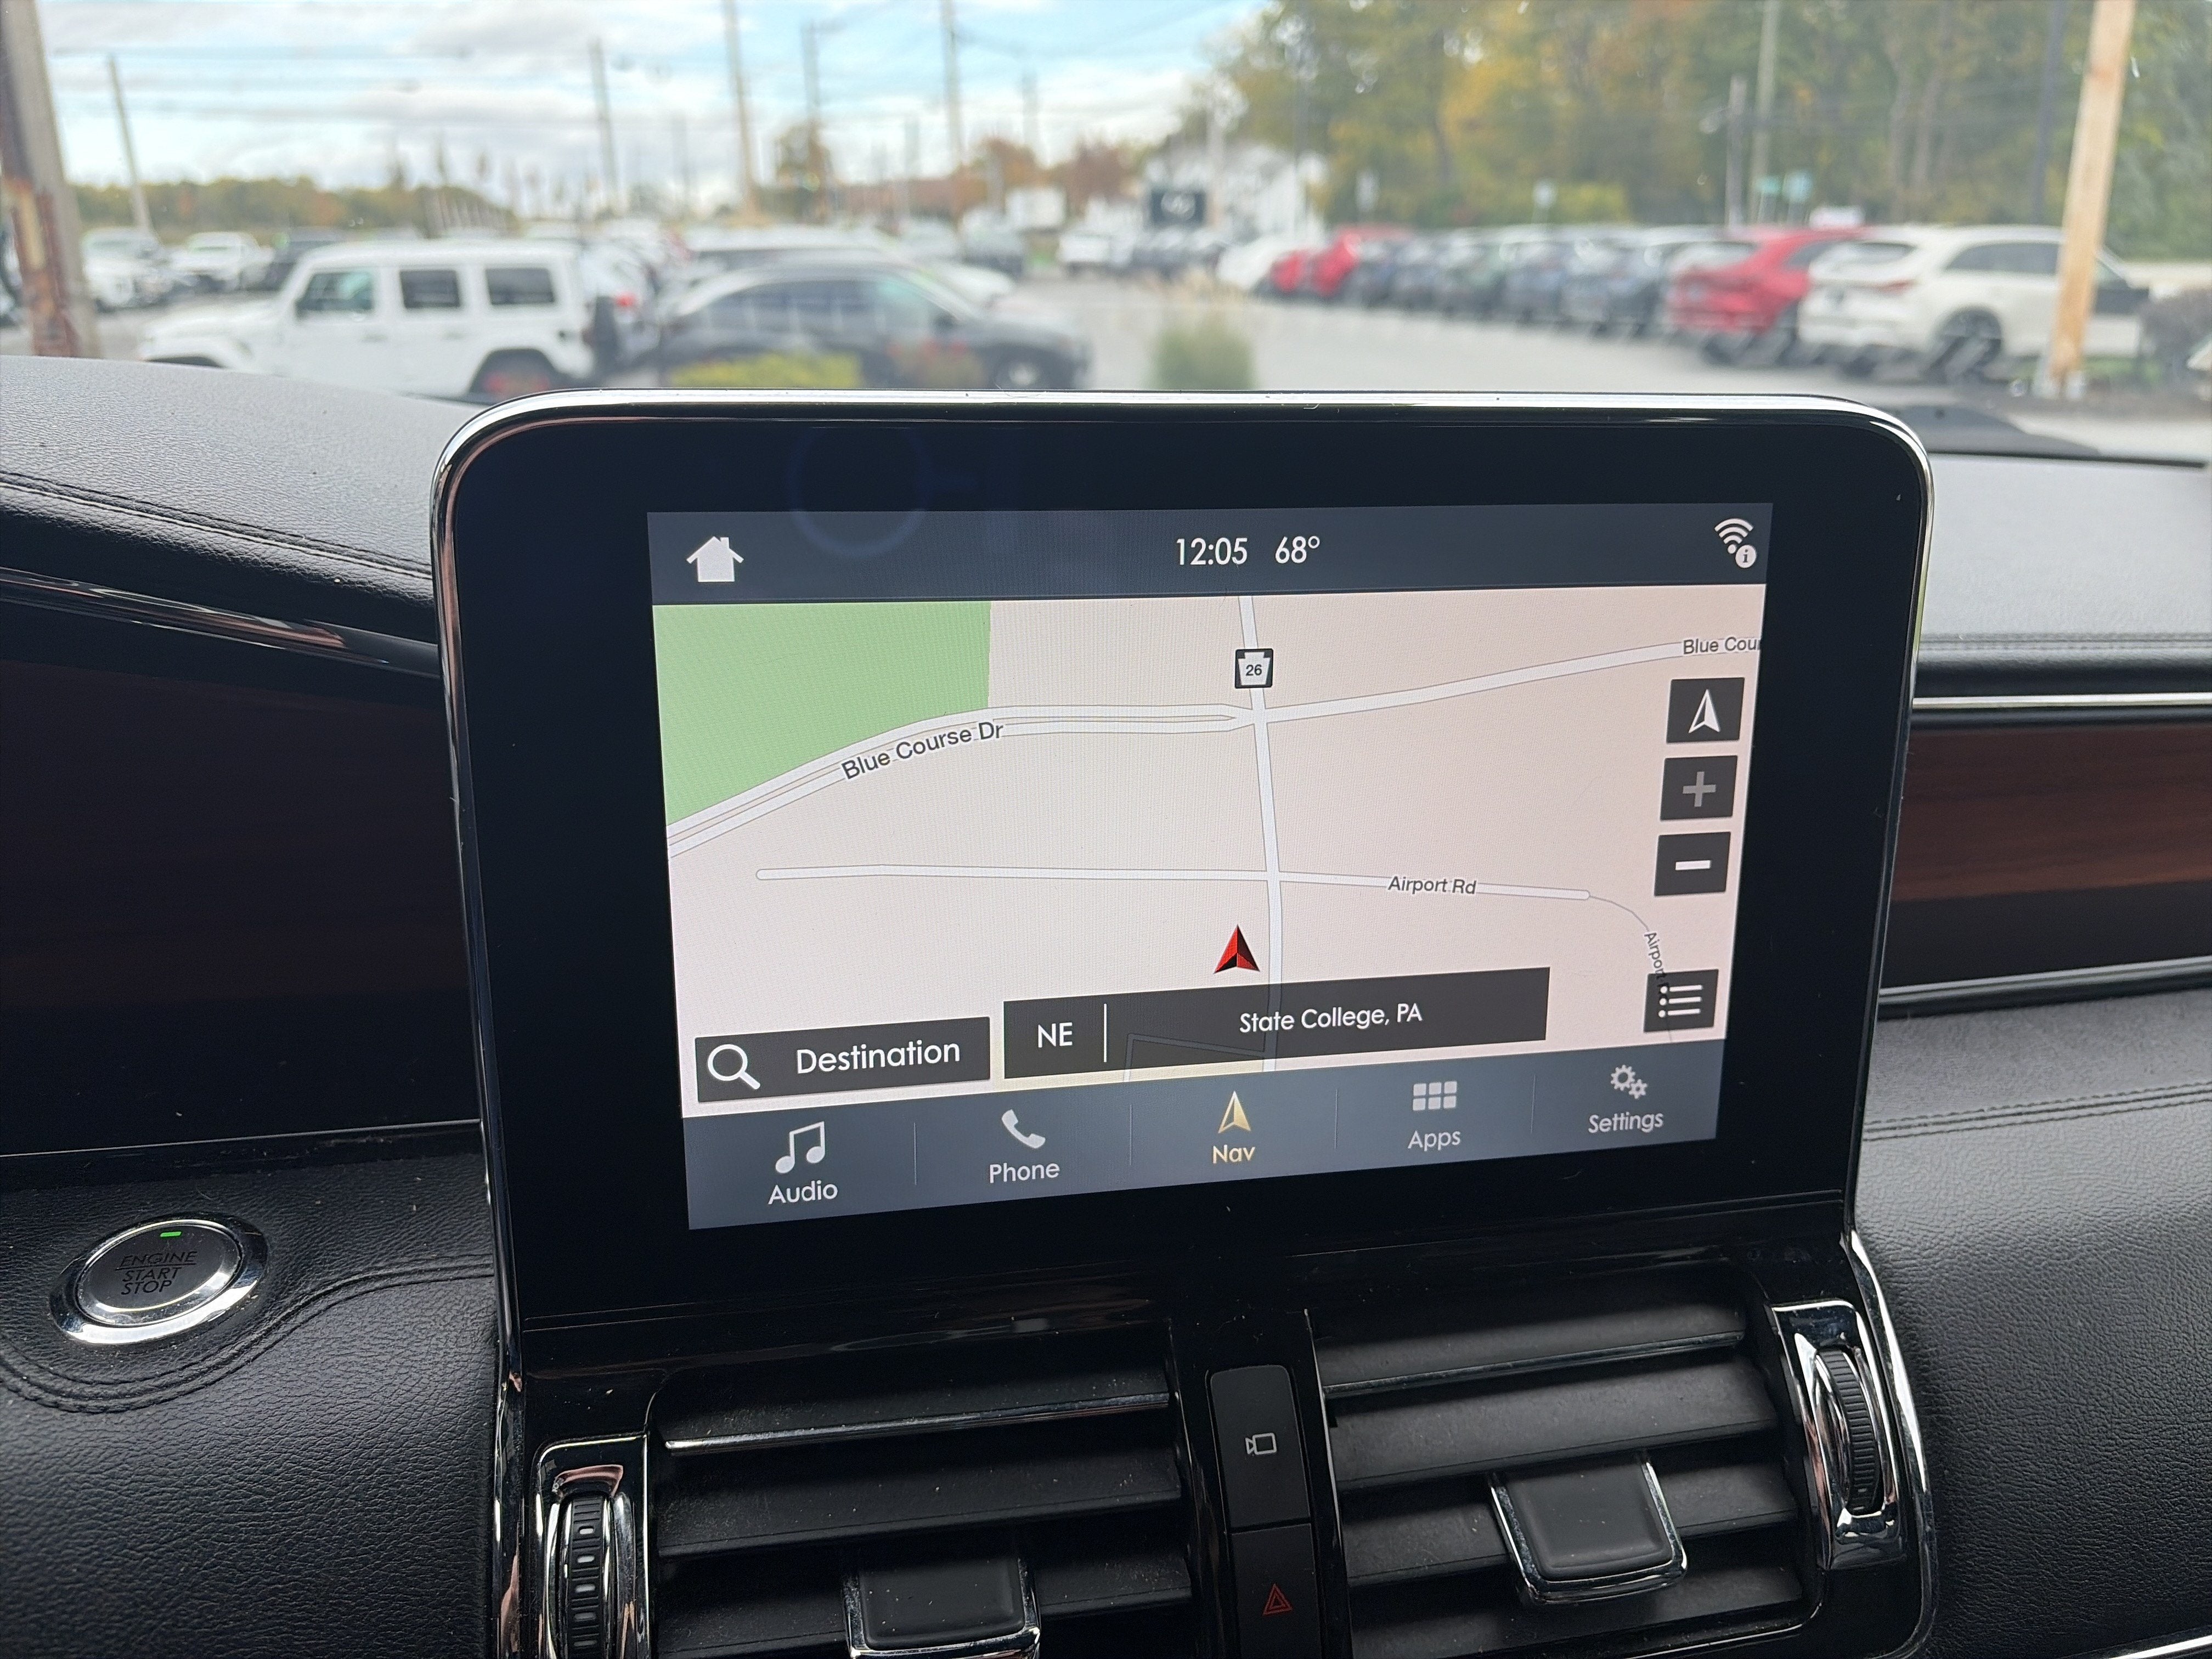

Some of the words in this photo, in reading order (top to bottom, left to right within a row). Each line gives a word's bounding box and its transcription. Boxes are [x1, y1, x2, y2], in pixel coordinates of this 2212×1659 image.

[1176, 537, 1248, 566] 12:05
[1274, 535, 1321, 564] 68°
[1683, 638, 1719, 654] Blue
[1245, 664, 1262, 676] 26
[842, 752, 891, 780] Blue
[895, 728, 973, 760] Course
[978, 721, 1003, 740] Dr
[1388, 876, 1447, 894] Airport
[1452, 879, 1476, 895] Rd
[1644, 932, 1667, 980] Airport
[1037, 1022, 1074, 1048] NE
[1239, 1012, 1294, 1034] State
[1301, 1007, 1390, 1031] College,
[1397, 1003, 1423, 1023] PA
[797, 1039, 961, 1074] Destination
[1588, 1110, 1664, 1133] Settings
[1408, 1129, 1461, 1151] Apps
[1213, 1144, 1255, 1164] Nav
[989, 1161, 1060, 1183] Phone
[769, 1181, 838, 1205] Audio
[121, 1251, 198, 1266] ENGINE
[122, 1267, 182, 1282] START
[121, 1280, 172, 1295] STOP
